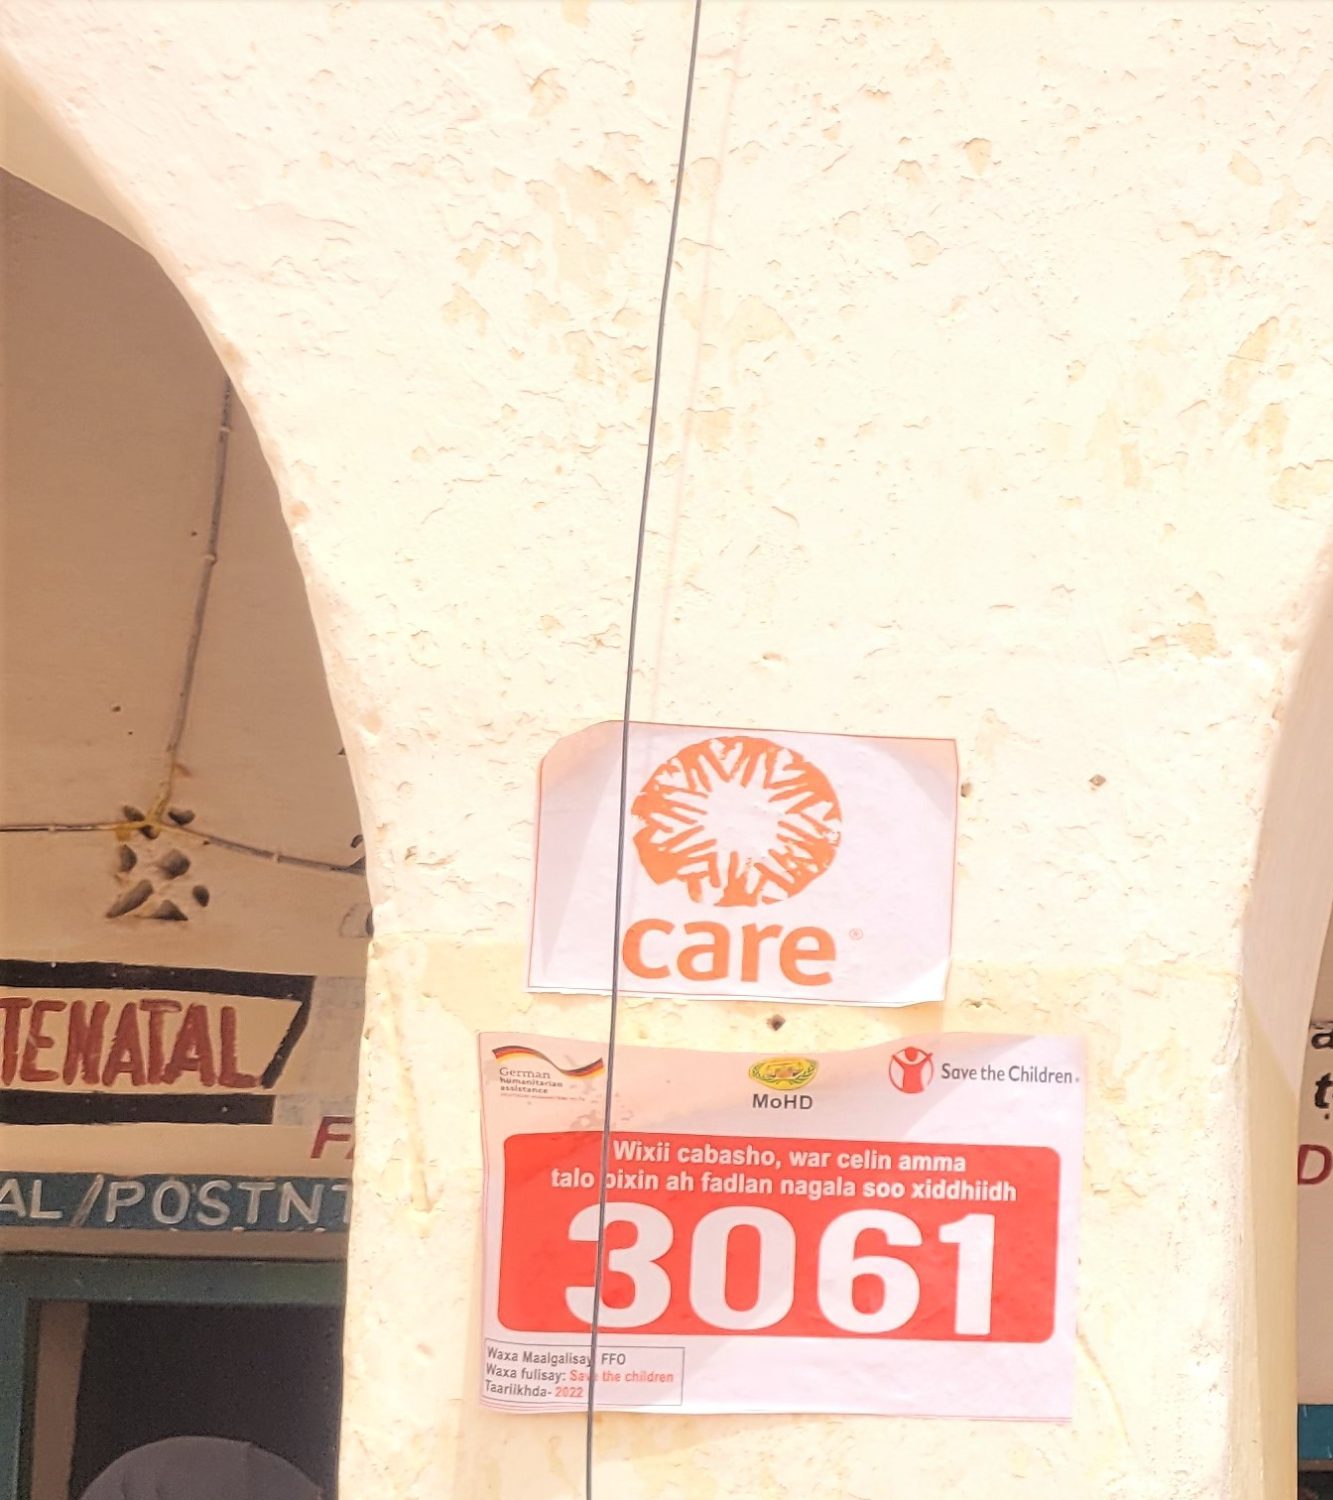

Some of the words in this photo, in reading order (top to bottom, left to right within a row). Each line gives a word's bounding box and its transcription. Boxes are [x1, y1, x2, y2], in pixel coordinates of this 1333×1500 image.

[622, 918, 836, 986] care
[0, 997, 260, 1088] TENATAL
[500, 1066, 551, 1079] German
[941, 1062, 977, 1080] Save
[981, 1064, 1005, 1081] the
[752, 1093, 813, 1110] MoHD
[311, 1117, 353, 1159] F
[613, 1140, 669, 1162] Wixii
[678, 1144, 782, 1170] cabasho,
[789, 1151, 831, 1167] war
[837, 1150, 891, 1170] celin
[898, 1154, 966, 1172] amma
[551, 1168, 594, 1188] talo
[666, 1171, 694, 1191] ah
[701, 1172, 772, 1194] fadlan
[780, 1176, 856, 1200] nagala
[862, 1181, 905, 1198] soo
[564, 1201, 996, 1336] 3061
[487, 1346, 518, 1362] Waxa
[601, 1353, 626, 1364] FFO
[486, 1363, 517, 1378] Waxa
[521, 1366, 566, 1384] fulisay:
[570, 1370, 598, 1381] Sav
[602, 1371, 621, 1382] the
[625, 1371, 674, 1382] children
[555, 1387, 584, 1397] 2022
